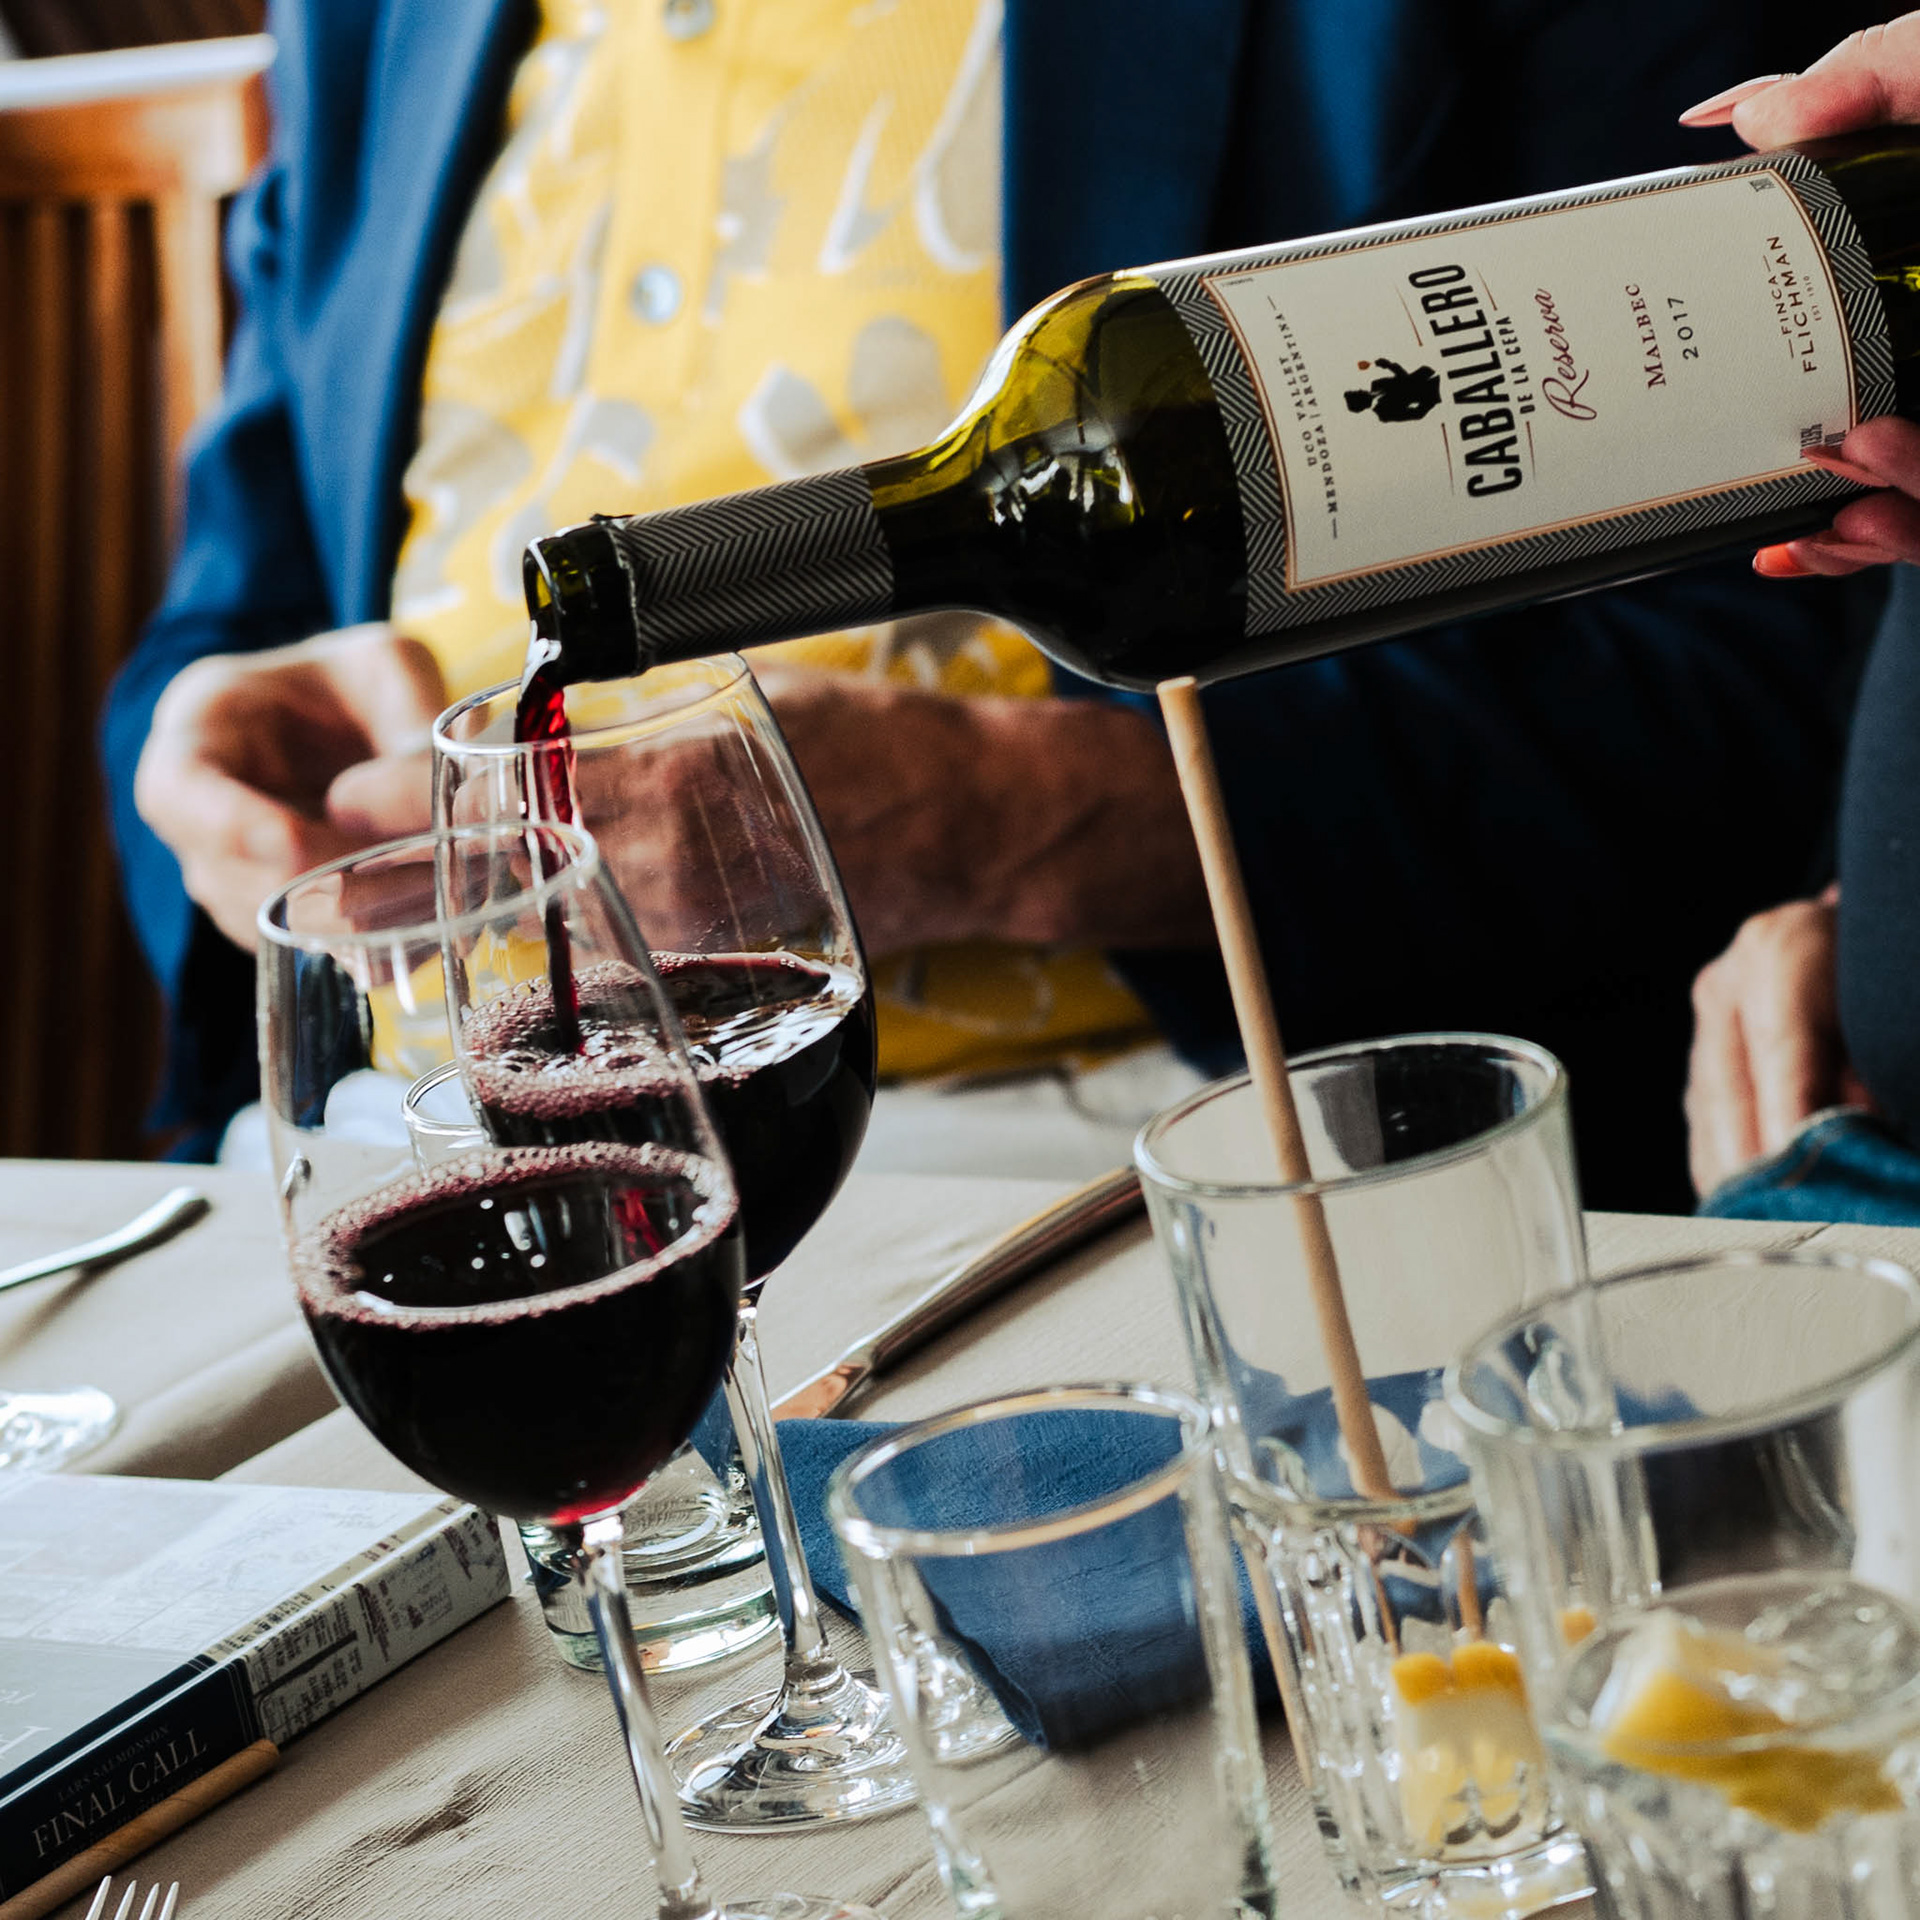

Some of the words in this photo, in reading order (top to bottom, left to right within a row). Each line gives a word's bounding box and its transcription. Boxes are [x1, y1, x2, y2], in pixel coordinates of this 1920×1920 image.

[1495, 316, 1521, 355] CEPA
[1625, 283, 1667, 390] MALBEC
[1667, 297, 1699, 360] 2017
[1766, 236, 1817, 373] FLICHMAN
[1768, 275, 1792, 335] FINCA
[1275, 313, 1318, 407] ARGENTINA
[1408, 264, 1522, 497] CABALLERO
[1511, 364, 1529, 385] LA
[1535, 288, 1597, 421] Reserva
[1279, 356, 1306, 421] VALLEY
[1517, 393, 1536, 414] DE
[1302, 430, 1317, 467] UCO
[1315, 424, 1338, 514] MENDOZA
[32, 1782, 126, 1859] FINAL
[129, 1728, 208, 1794] CALL
[58, 1773, 93, 1802] LARS
